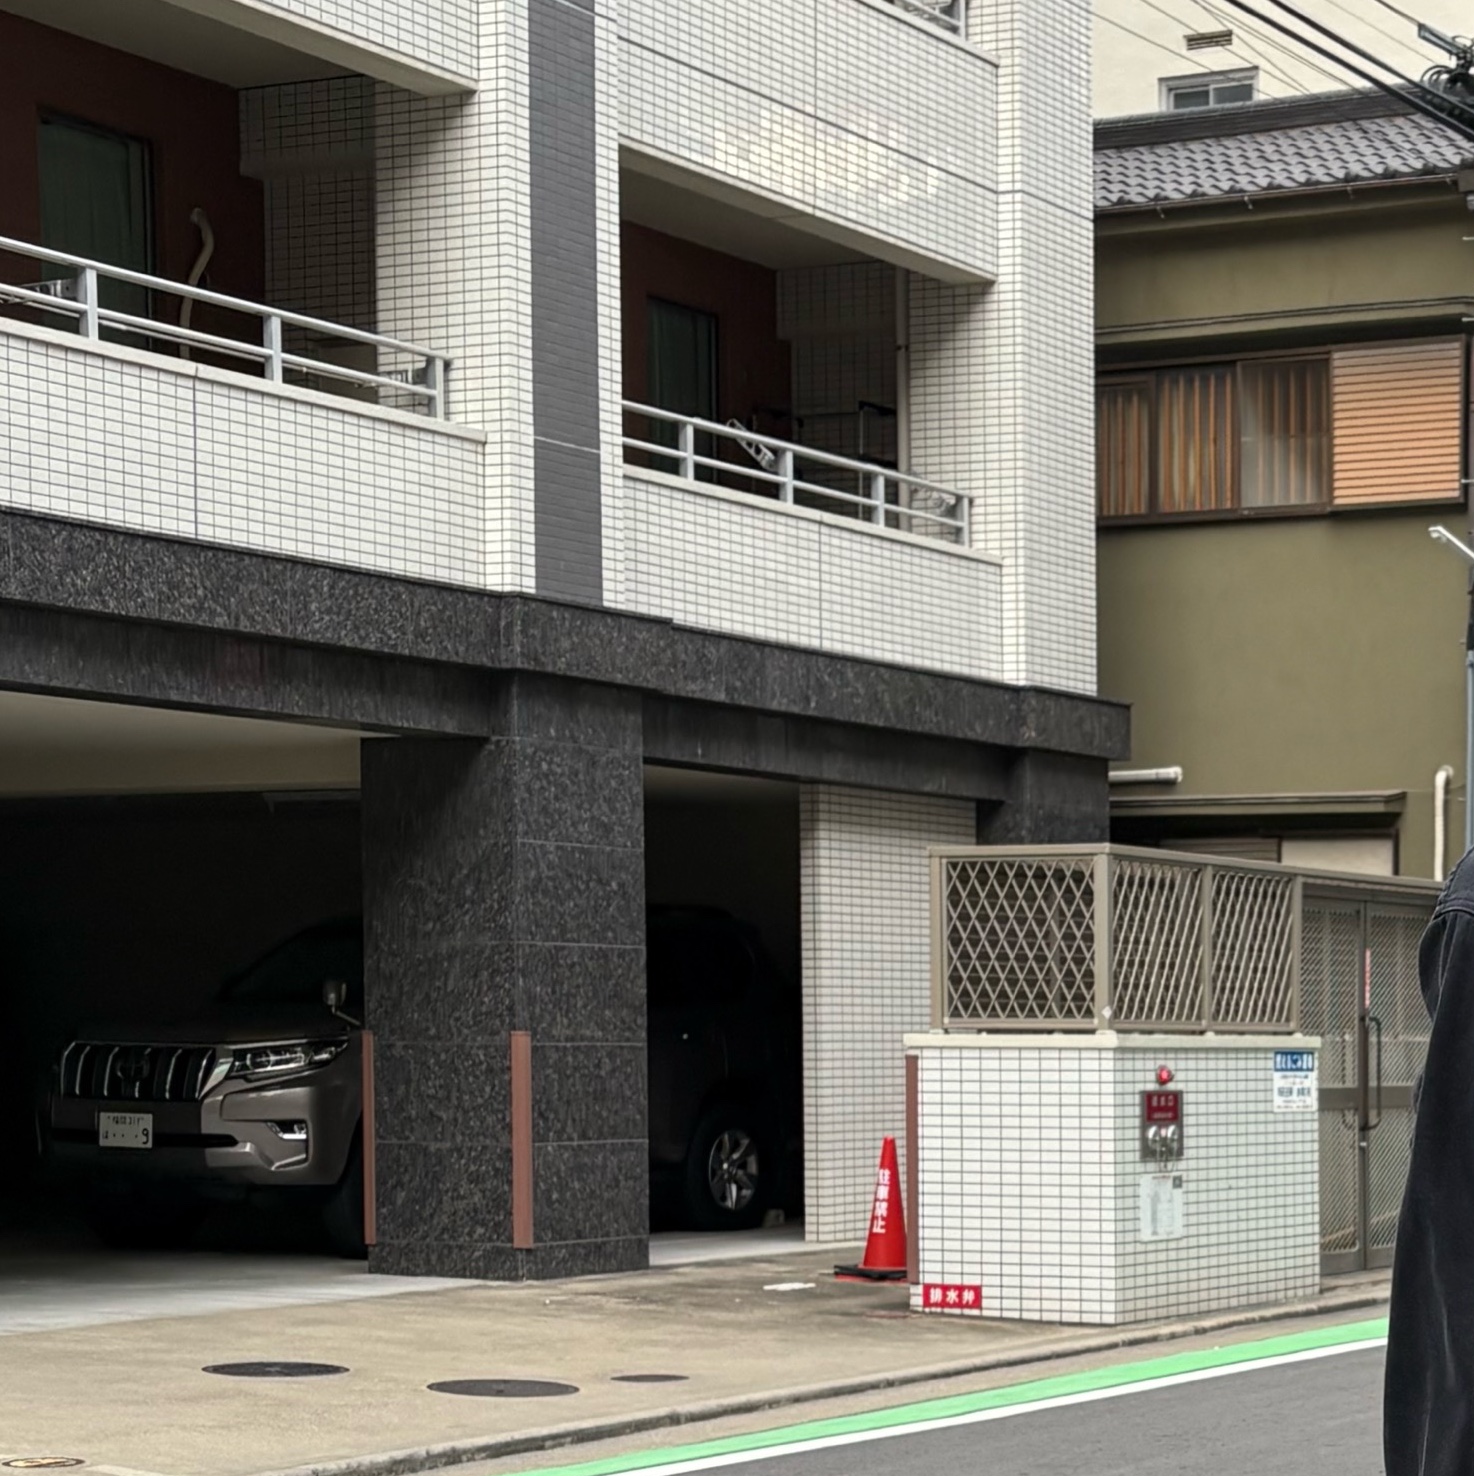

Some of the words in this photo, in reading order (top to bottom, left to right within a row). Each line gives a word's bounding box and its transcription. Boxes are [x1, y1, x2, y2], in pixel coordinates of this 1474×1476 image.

[872, 1168, 891, 1234] 駐車禁止
[929, 1286, 976, 1305] 排水弁
